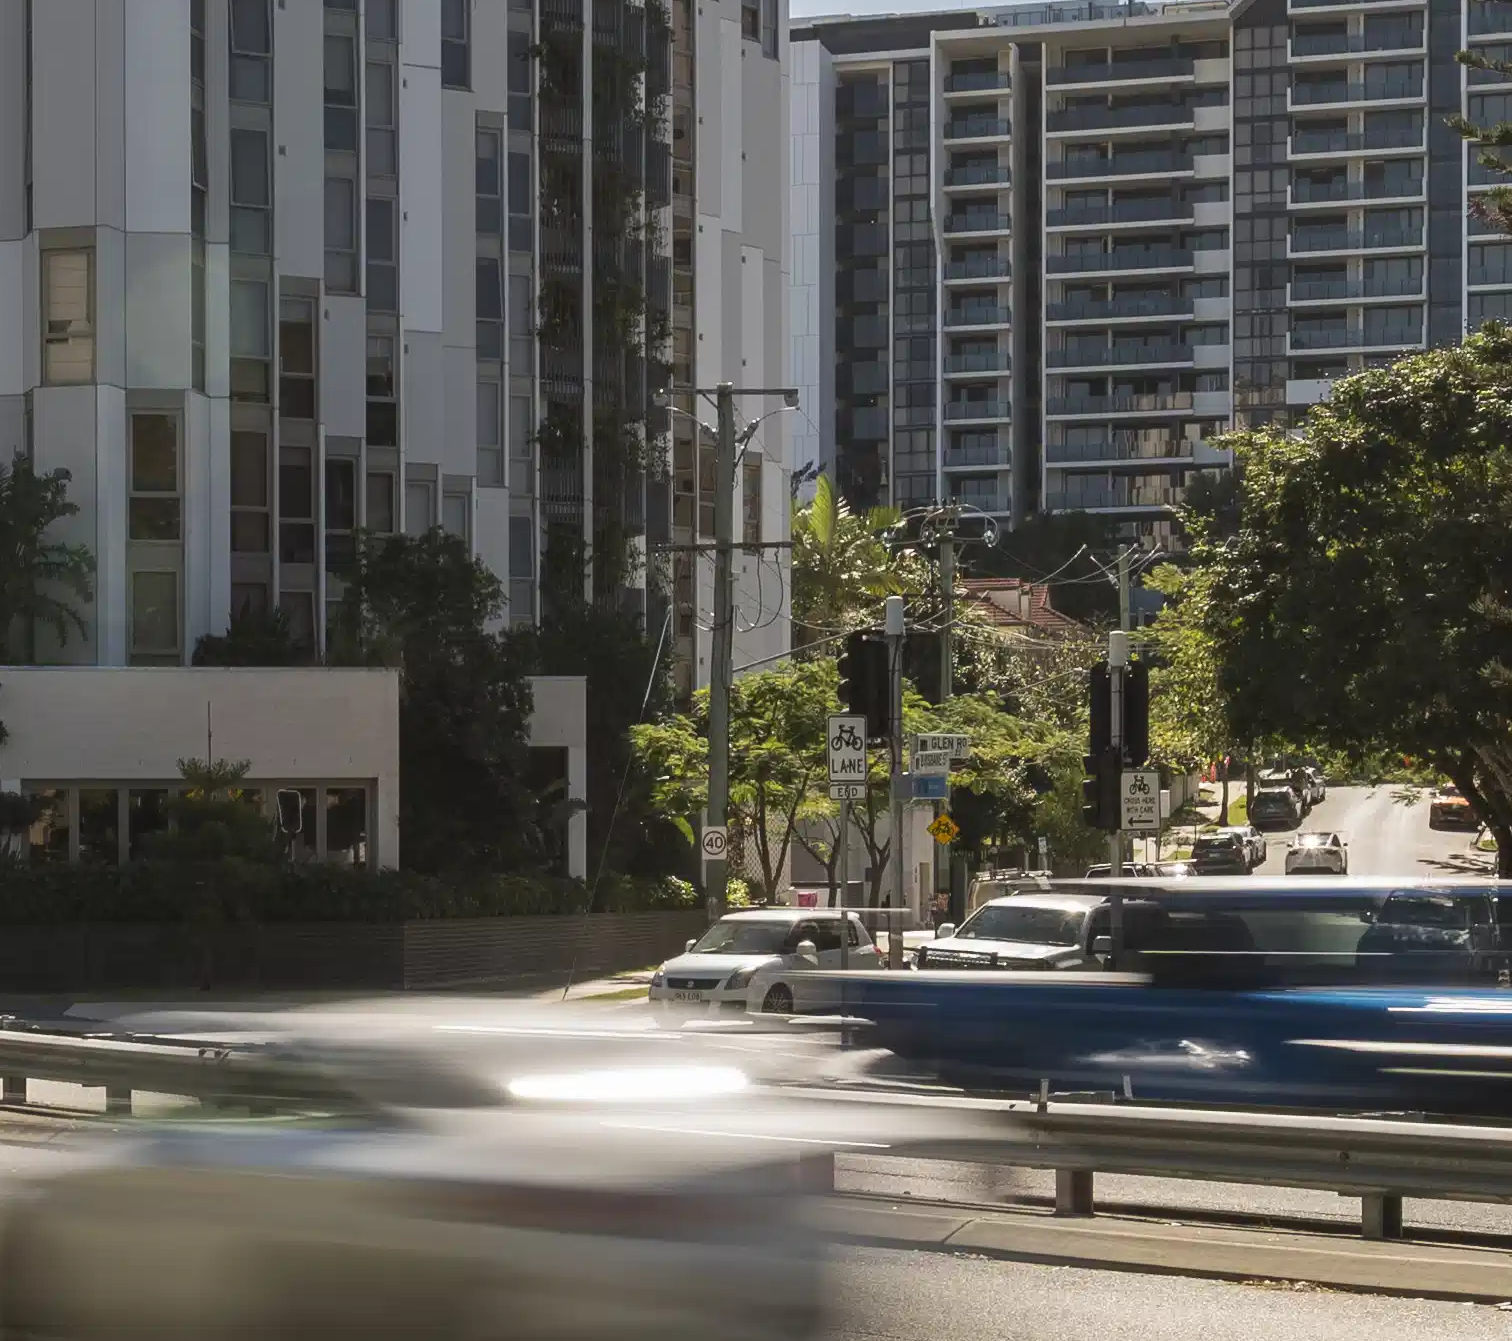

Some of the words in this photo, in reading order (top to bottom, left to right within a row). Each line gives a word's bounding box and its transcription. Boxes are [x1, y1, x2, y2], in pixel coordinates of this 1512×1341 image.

[931, 737, 954, 750] GLEN
[831, 758, 864, 774] LANE
[837, 788, 858, 798] END
[706, 837, 724, 849] 40
